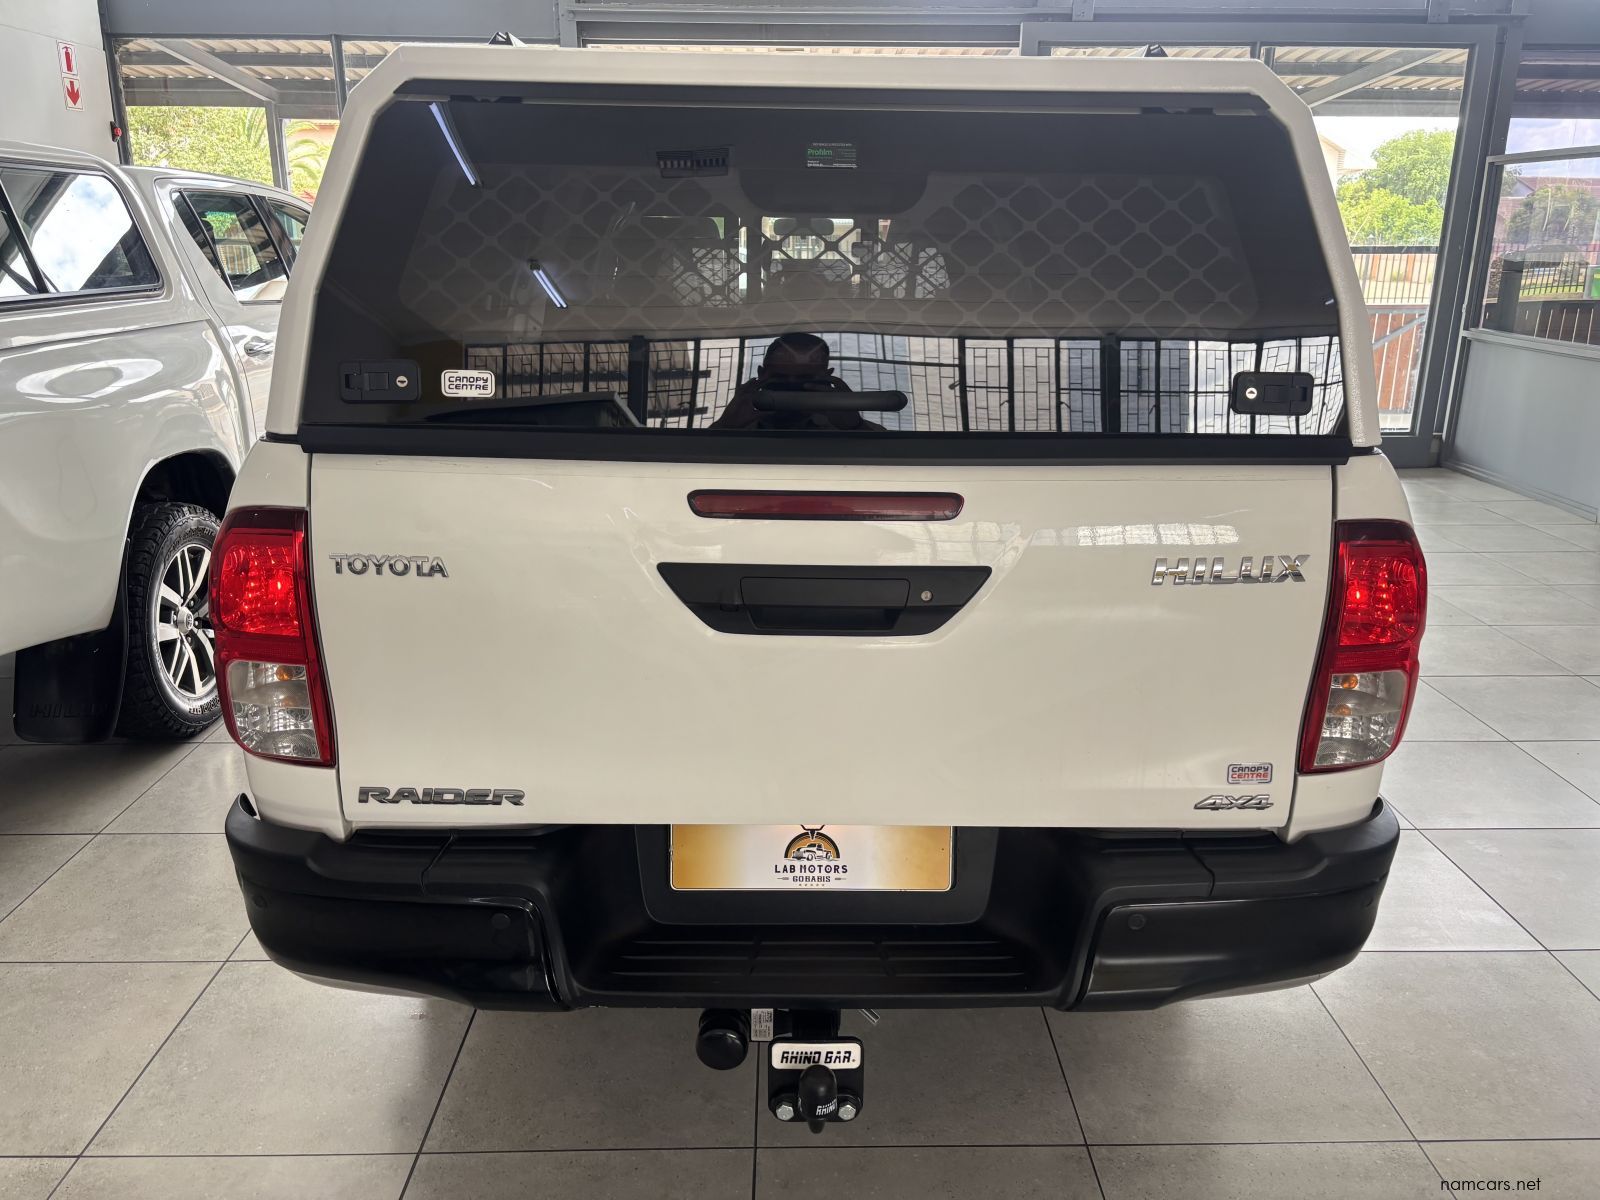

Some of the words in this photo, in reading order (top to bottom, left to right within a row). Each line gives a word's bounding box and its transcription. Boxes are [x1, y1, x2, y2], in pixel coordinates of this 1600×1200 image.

[808, 148, 833, 156] Profilm
[329, 553, 449, 577] TOYOTA
[1151, 554, 1310, 585] HILUX
[358, 787, 525, 806] RAIDER
[775, 865, 796, 873] LAB
[800, 865, 848, 874] MOTORS
[780, 1051, 821, 1064] RHINO
